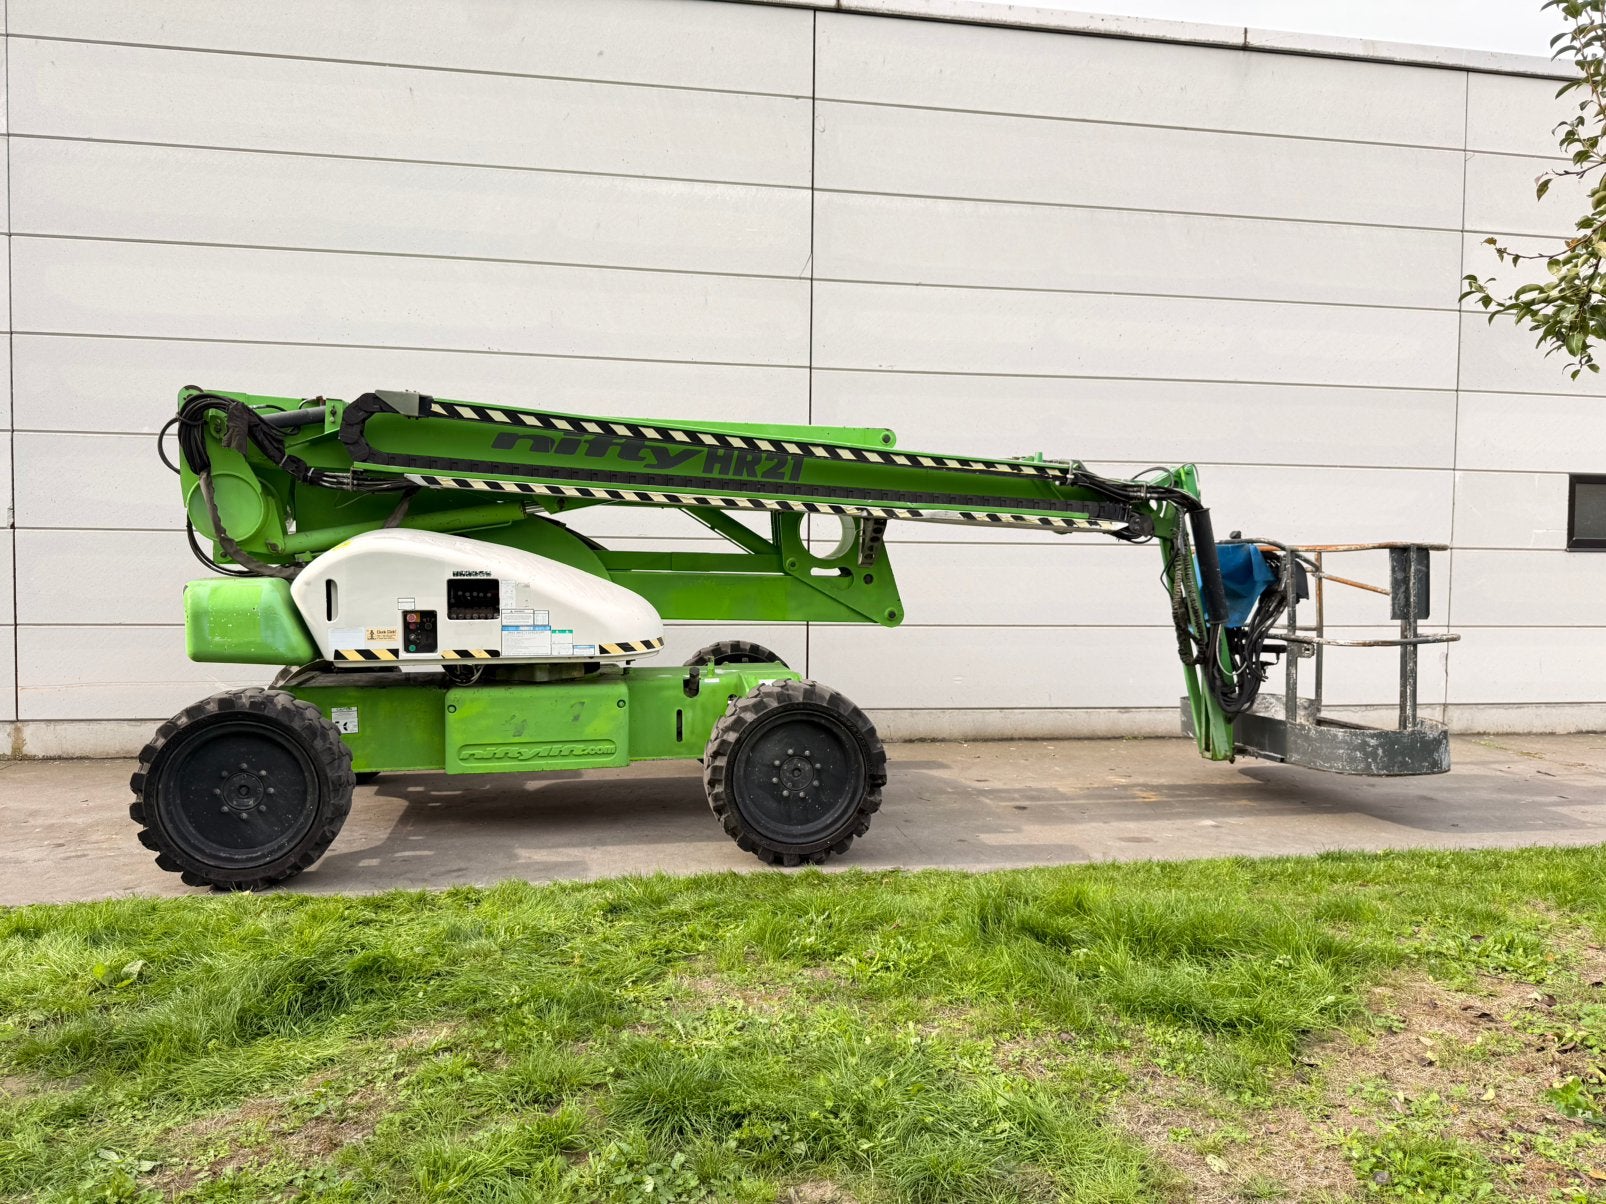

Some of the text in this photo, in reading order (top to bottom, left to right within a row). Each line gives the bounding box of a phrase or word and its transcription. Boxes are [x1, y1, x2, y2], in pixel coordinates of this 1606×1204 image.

[491, 431, 804, 482] nifty HR21
[459, 745, 616, 760] niftylift.com
